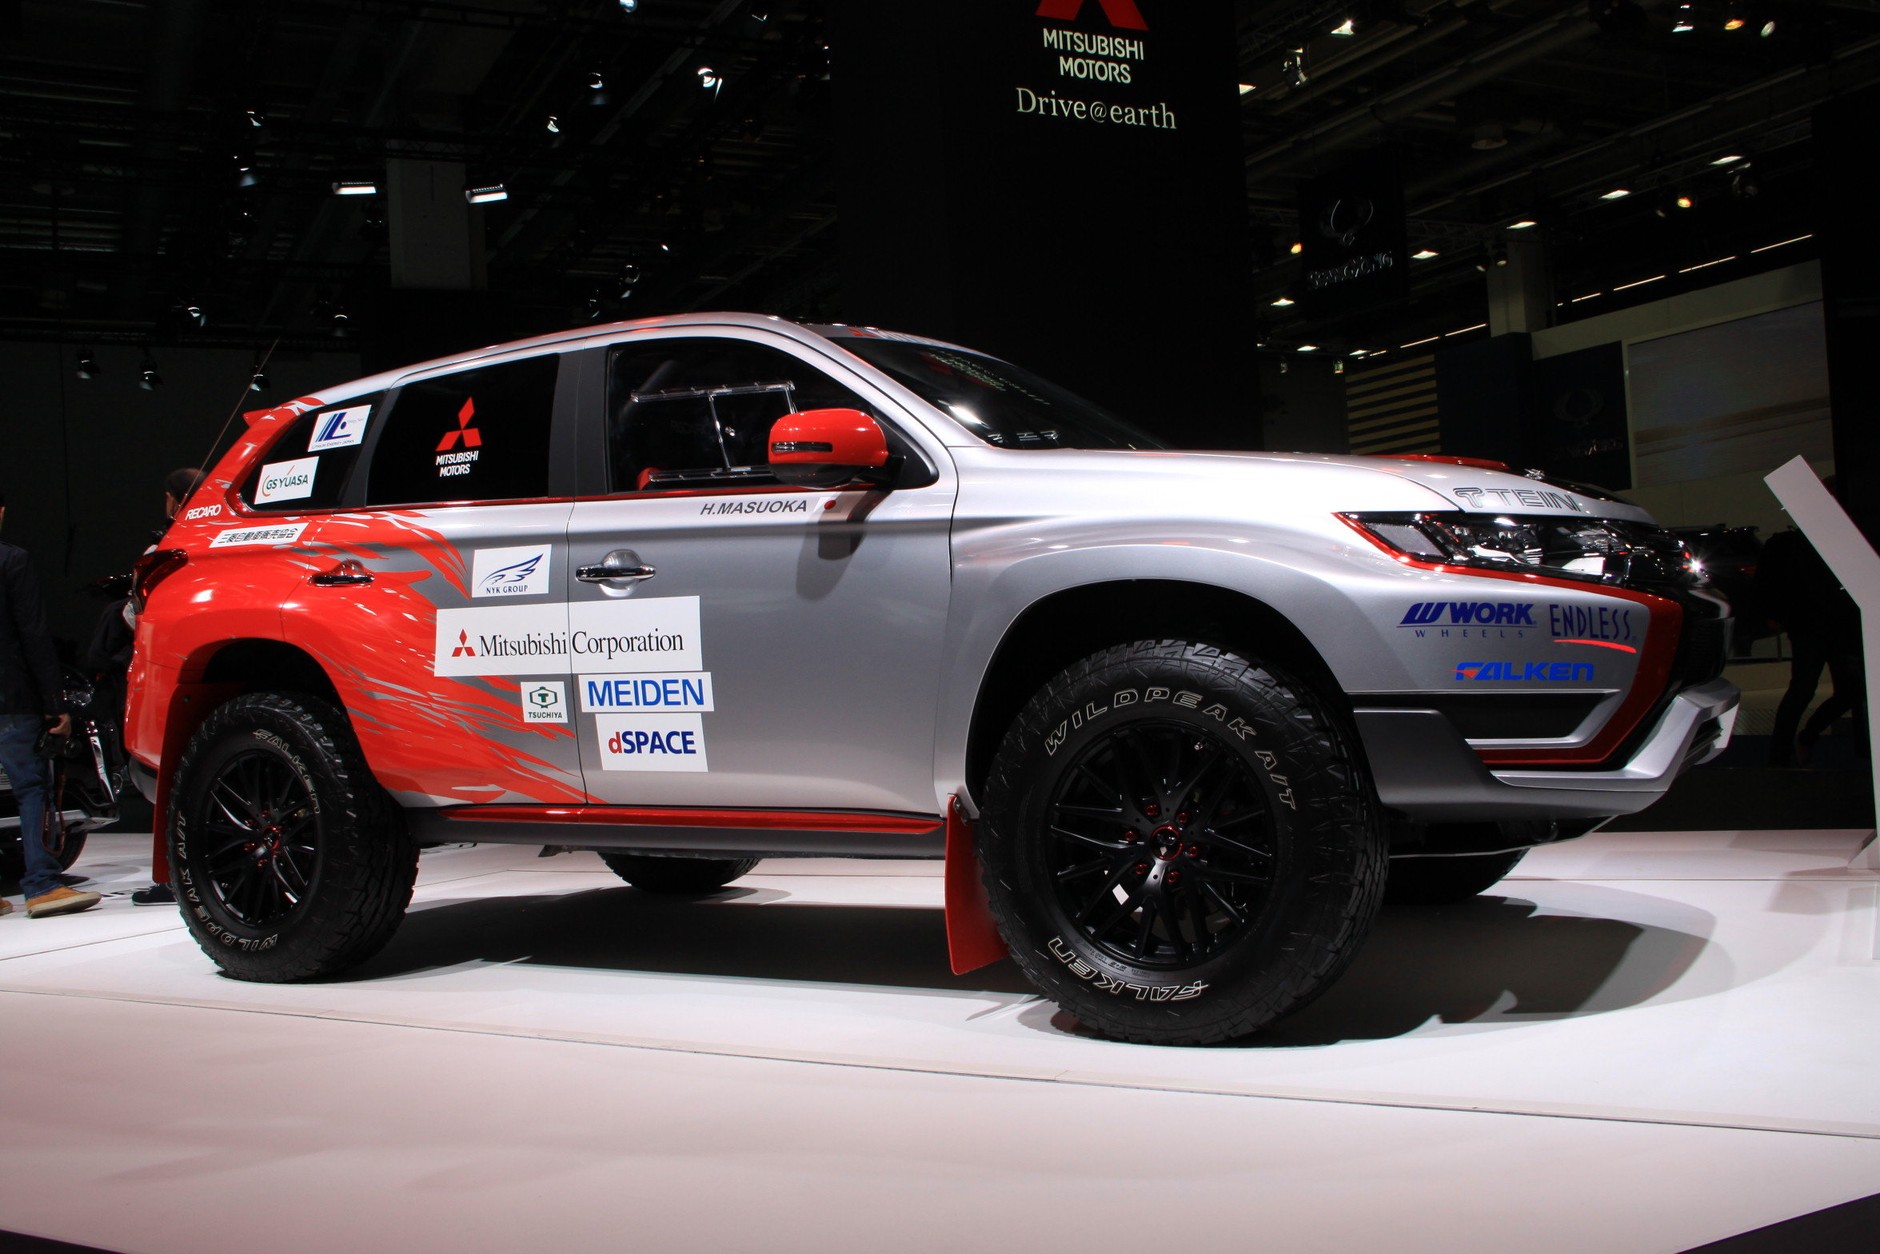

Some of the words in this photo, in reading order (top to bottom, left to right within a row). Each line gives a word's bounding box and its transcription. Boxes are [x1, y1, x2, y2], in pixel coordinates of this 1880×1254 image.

[1043, 28, 1145, 60] MITSUBISHI
[1059, 56, 1132, 84] MOTORS
[1016, 87, 1177, 130] Drive@earth
[436, 450, 479, 466] MITSUBISHI
[266, 478, 277, 490] GS
[279, 474, 309, 487] YUASA
[439, 464, 471, 477] MOTORS
[185, 504, 222, 521] RECARO
[700, 500, 807, 515] H.MASUOKA
[486, 584, 501, 594] NYK
[503, 584, 529, 594] GROUP
[1450, 602, 1536, 625] WORK
[1550, 604, 1632, 641] ENDLESS
[479, 631, 568, 657] Mitsubishi
[572, 628, 684, 660] Corporation
[1415, 629, 1524, 639] WHEELS
[1453, 661, 1594, 681] FALKEN
[588, 679, 704, 707] MEIDEN
[528, 711, 563, 719] TSUCHIYA
[1044, 687, 1258, 756] WILDPEAK
[608, 731, 697, 755] dSPACE
[253, 728, 321, 815] FALKEN
[182, 869, 280, 951] WILDPEAK
[1048, 937, 1209, 1001] FALKEN
